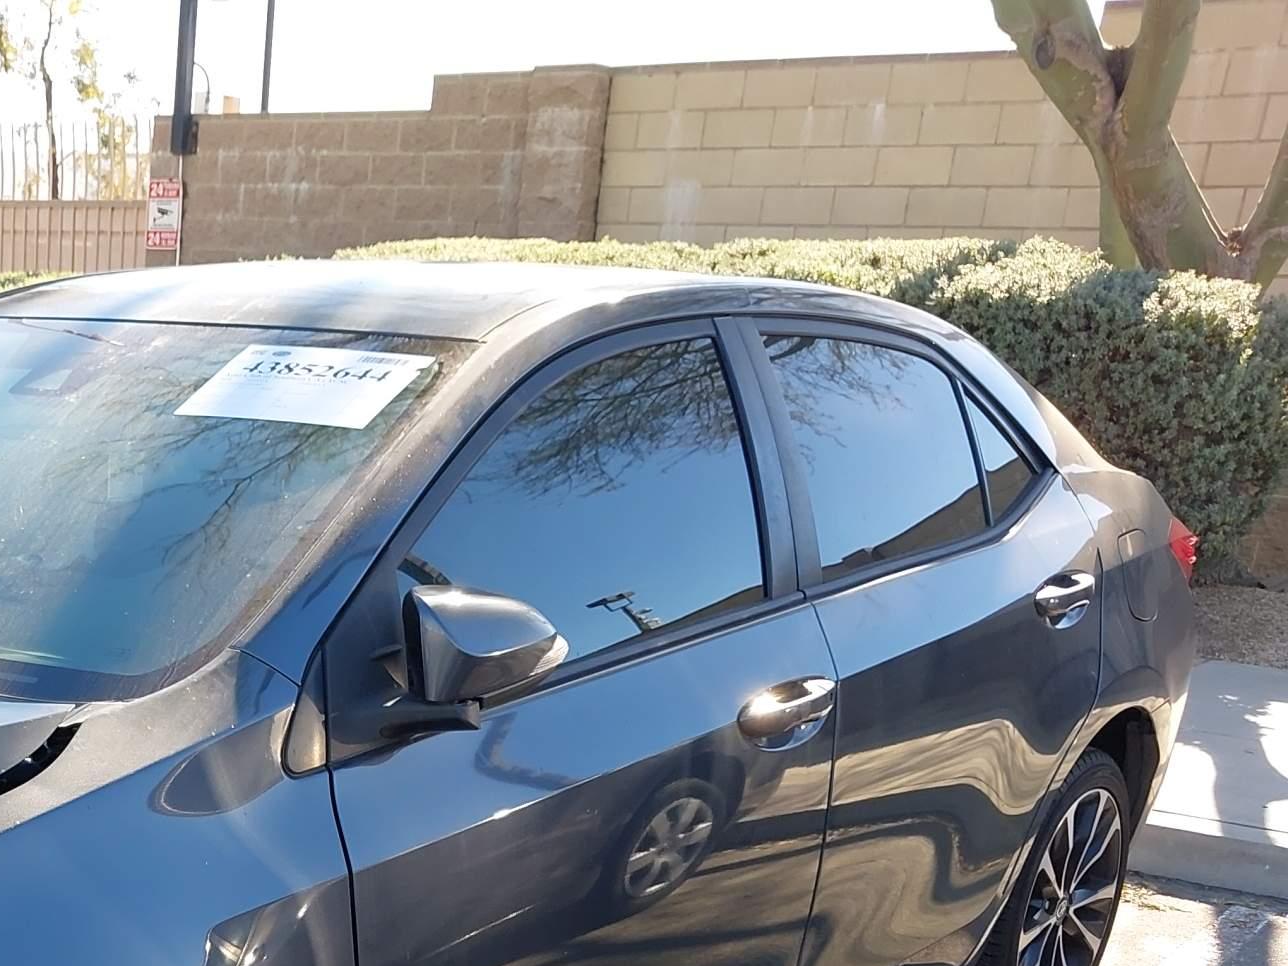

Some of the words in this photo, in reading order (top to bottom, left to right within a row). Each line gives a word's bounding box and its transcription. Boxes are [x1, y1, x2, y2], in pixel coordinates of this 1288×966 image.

[150, 183, 163, 197] 24
[148, 232, 160, 246] 24
[242, 360, 393, 382] 43852644
